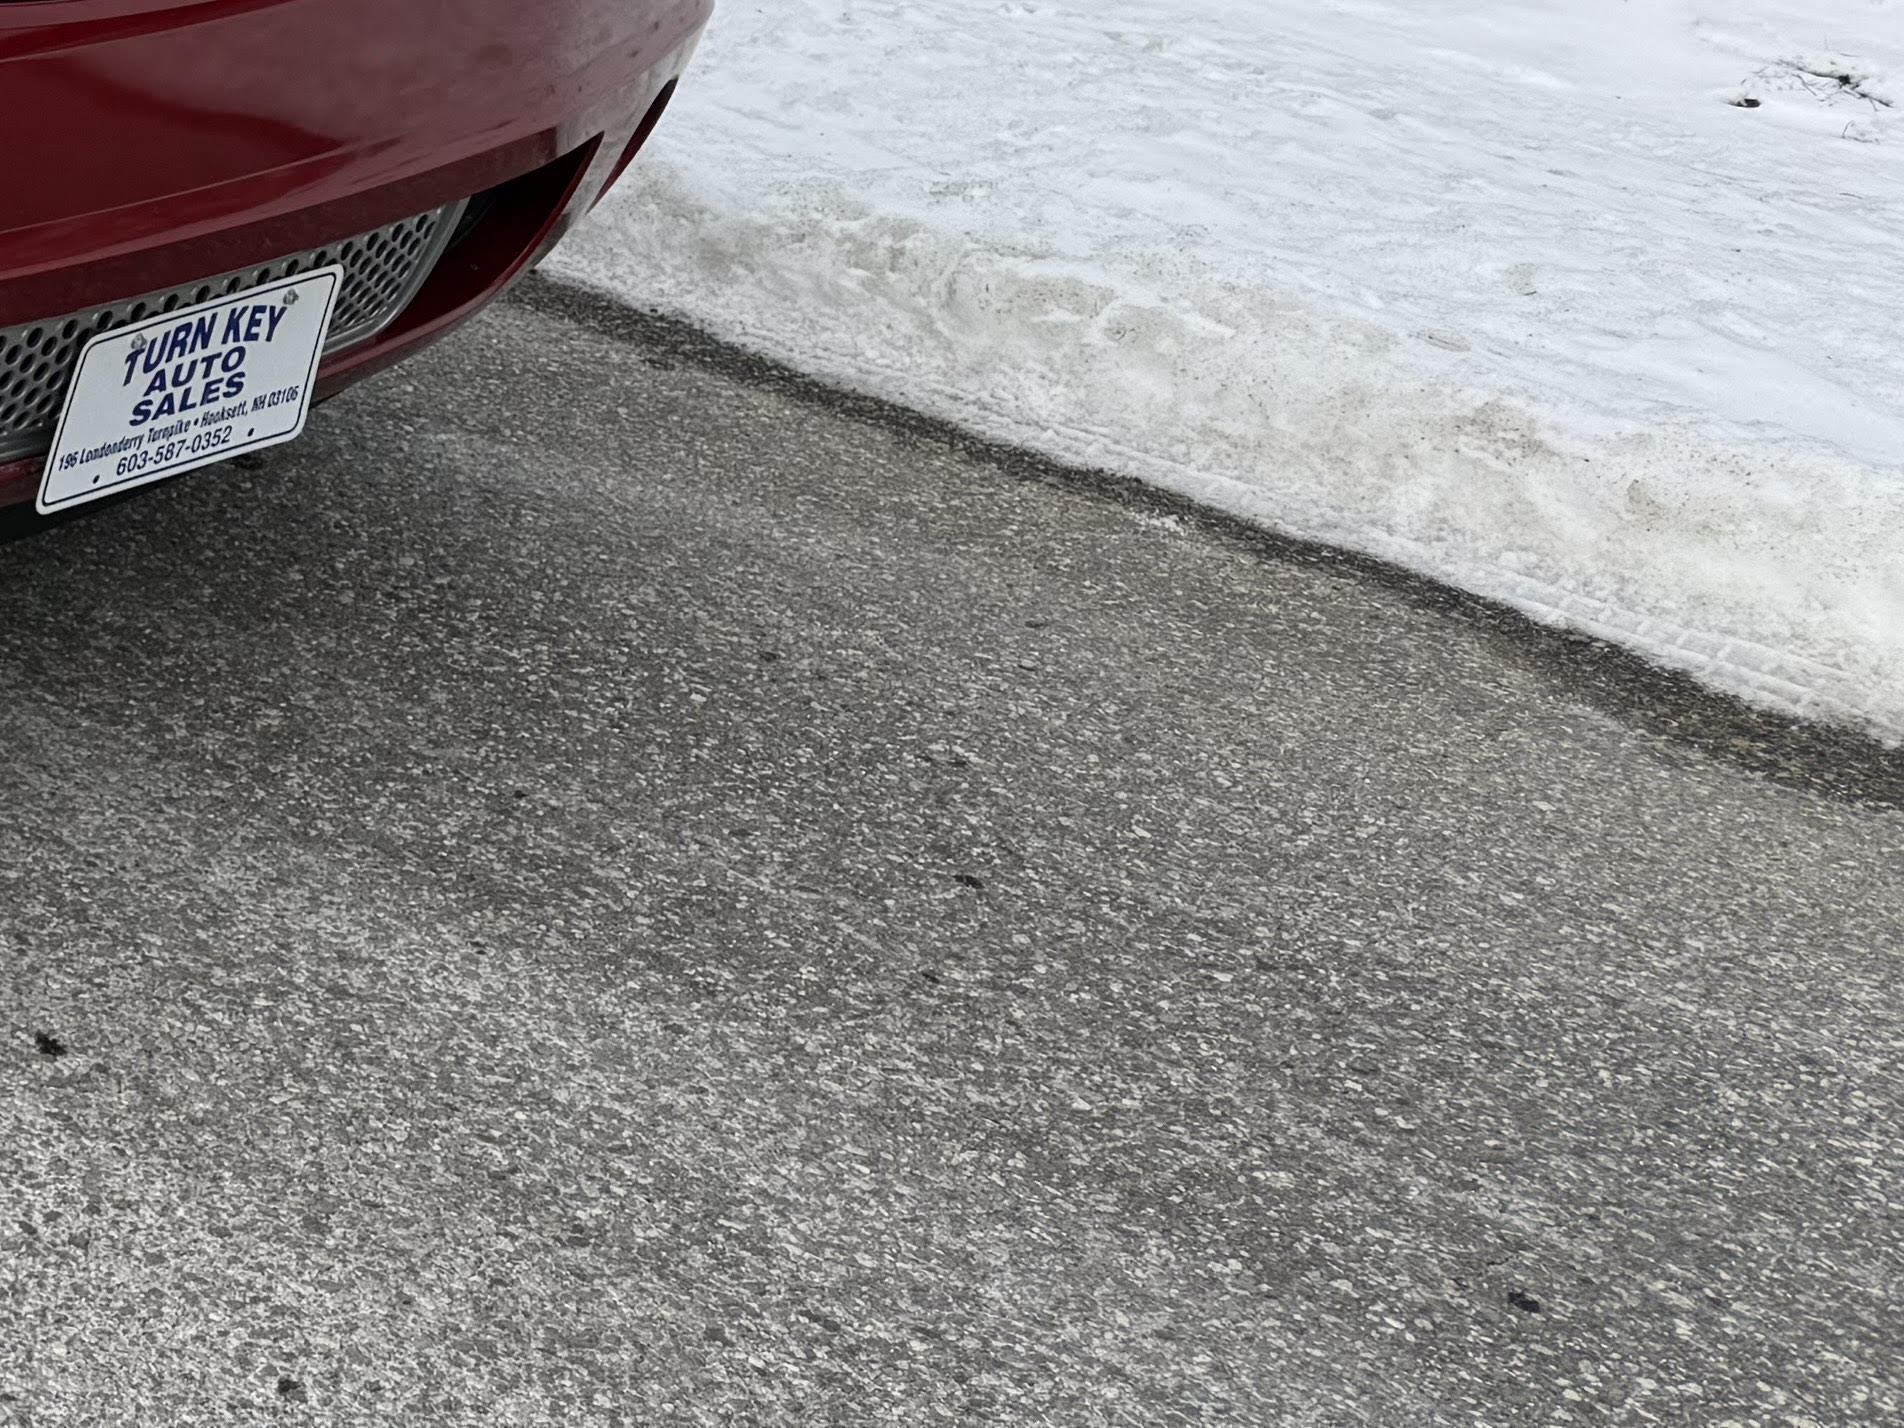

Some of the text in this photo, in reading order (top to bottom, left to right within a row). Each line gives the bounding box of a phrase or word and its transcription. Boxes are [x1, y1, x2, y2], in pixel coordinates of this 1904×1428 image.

[123, 305, 288, 387] TURN KEY
[143, 346, 246, 397] AUTO
[129, 372, 246, 426] SALES
[79, 434, 144, 464] Londonderry
[251, 393, 267, 412] NH
[116, 425, 233, 476] 603-587-0352
